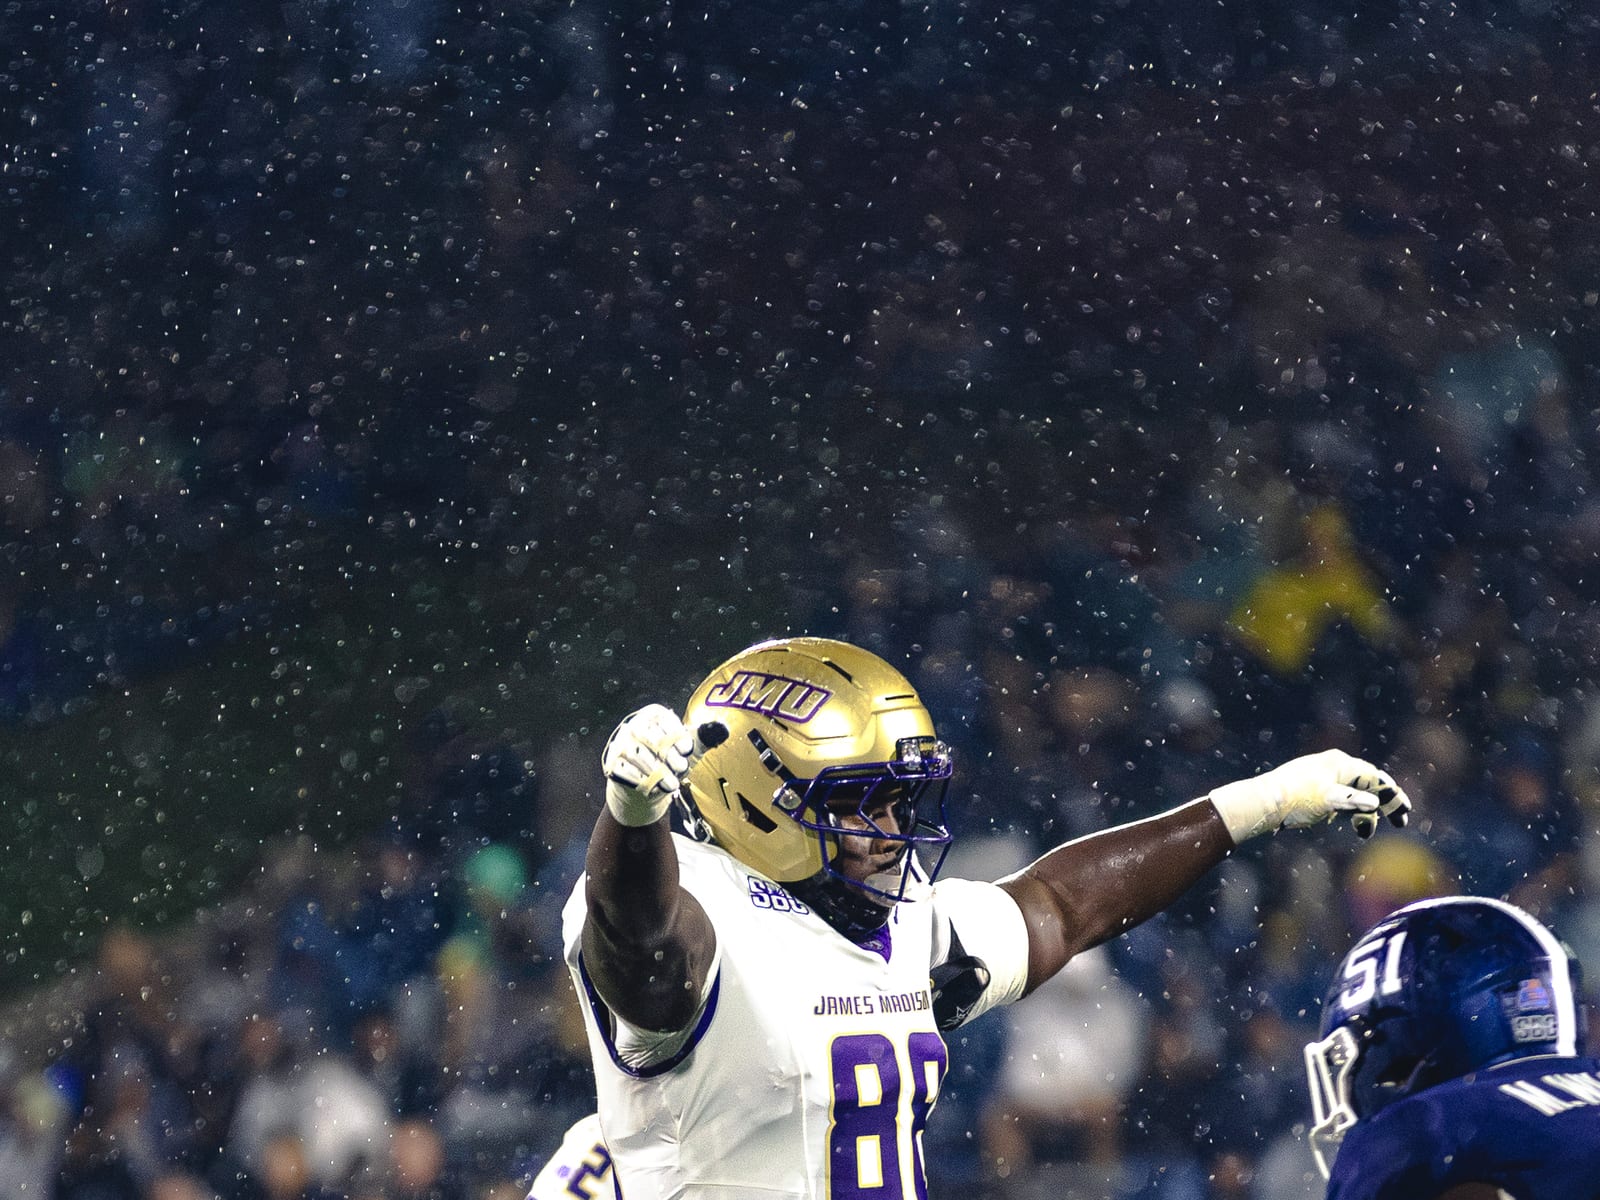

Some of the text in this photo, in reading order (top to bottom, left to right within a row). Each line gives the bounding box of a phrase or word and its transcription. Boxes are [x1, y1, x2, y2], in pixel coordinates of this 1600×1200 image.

[705, 670, 834, 724] JMU
[1339, 931, 1408, 1010] 51
[813, 995, 875, 1016] JAMES
